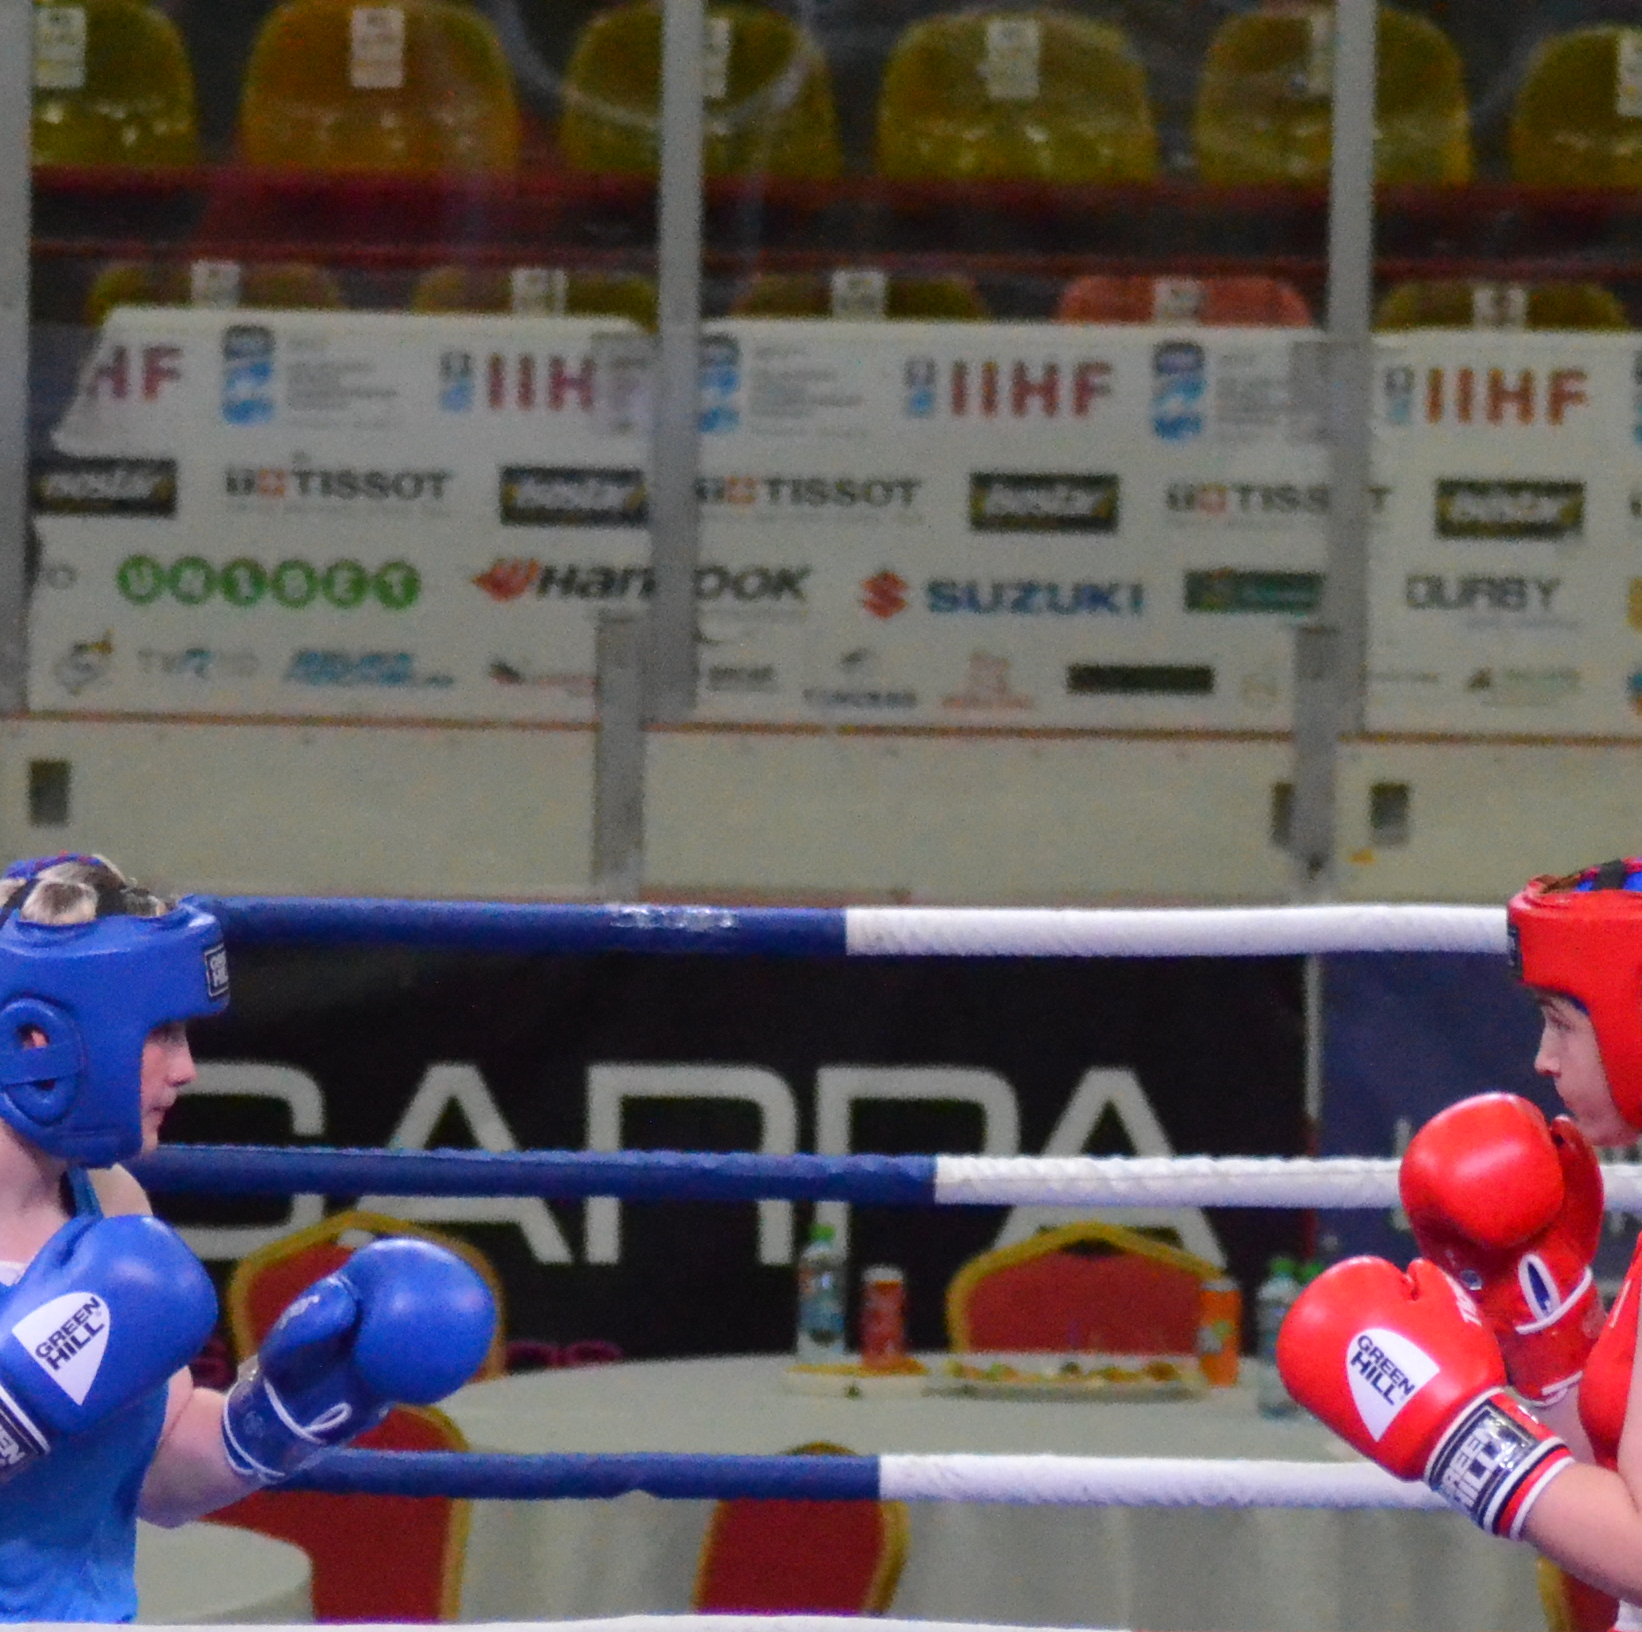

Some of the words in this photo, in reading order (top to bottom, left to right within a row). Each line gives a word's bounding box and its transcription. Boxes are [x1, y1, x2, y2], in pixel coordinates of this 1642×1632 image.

[949, 360, 1114, 420] IIHF
[1426, 366, 1589, 426] IIHF
[293, 470, 452, 501] TISSOT
[763, 478, 920, 508] TISSOT
[1238, 484, 1391, 516] TISST
[925, 578, 1145, 616] SUZUKI
[34, 1295, 100, 1363] GREEN
[44, 1317, 106, 1372] HILL
[1348, 1352, 1400, 1406] HILL
[1356, 1332, 1418, 1396] GREEN
